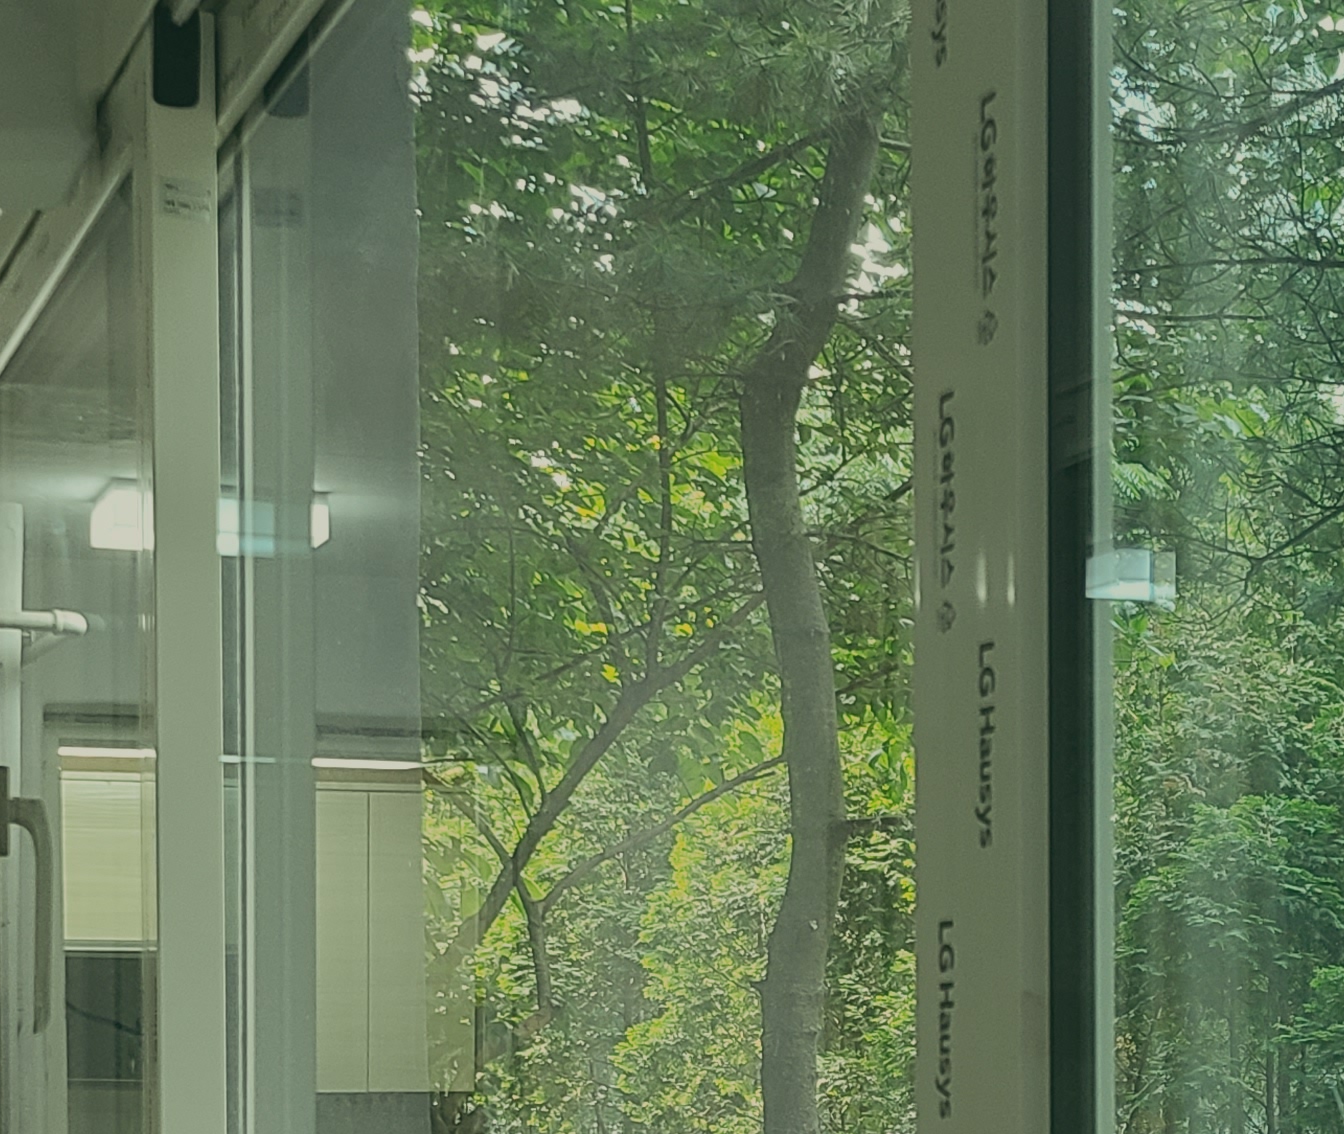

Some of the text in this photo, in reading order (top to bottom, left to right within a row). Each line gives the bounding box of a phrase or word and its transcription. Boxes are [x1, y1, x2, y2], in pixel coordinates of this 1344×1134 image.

[975, 641, 996, 849] LG Hausys
[934, 920, 955, 1121] LG Hausys
